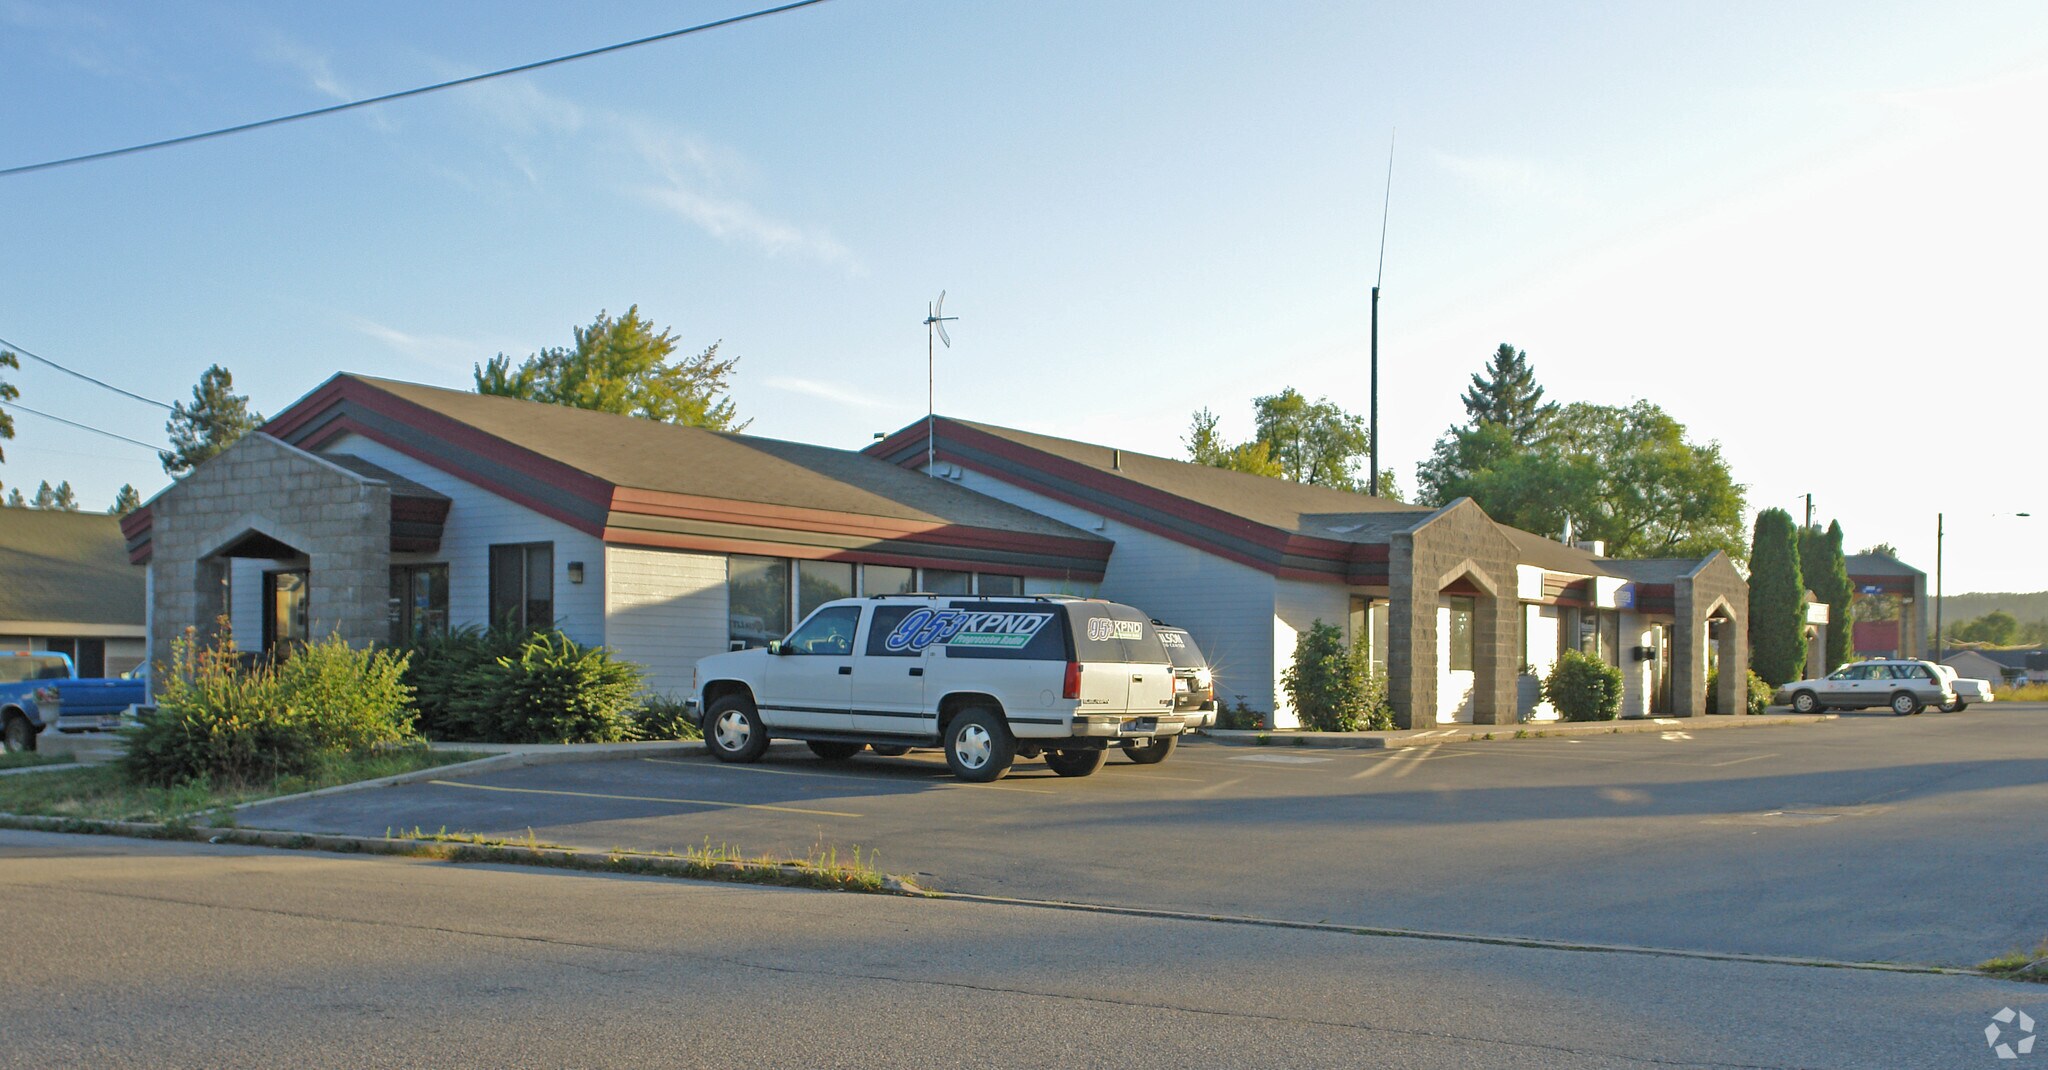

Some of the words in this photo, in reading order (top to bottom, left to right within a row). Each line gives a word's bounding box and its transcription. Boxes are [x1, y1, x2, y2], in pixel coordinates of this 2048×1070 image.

[886, 607, 967, 650] 95.3
[960, 613, 1043, 634] KPND
[1113, 621, 1141, 632] KPND
[954, 634, 1001, 644] Progressive
[999, 636, 1025, 645] Radio
[1158, 632, 1183, 643] ILSON
